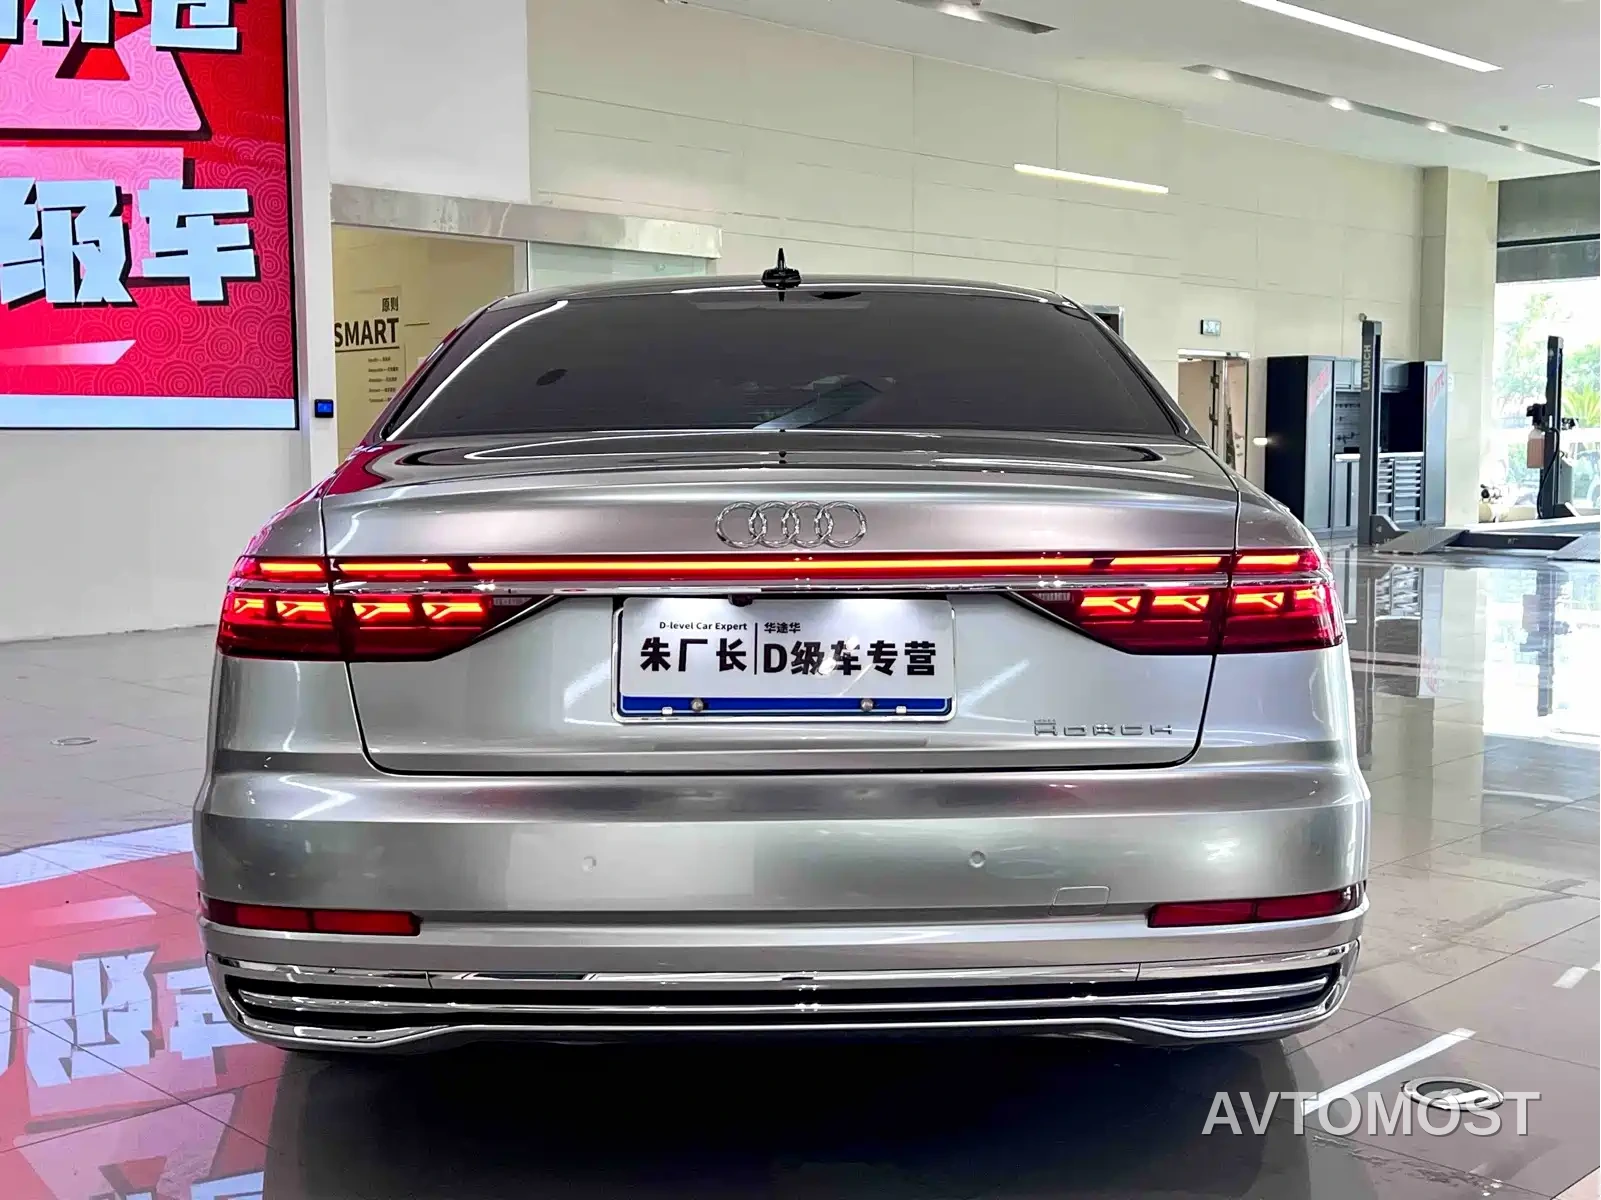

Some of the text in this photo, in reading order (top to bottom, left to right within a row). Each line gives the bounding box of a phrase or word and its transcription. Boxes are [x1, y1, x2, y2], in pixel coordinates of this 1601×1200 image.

[0, 177, 257, 304] 级车
[381, 296, 399, 312] 原则
[334, 317, 400, 348] SMART
[1361, 344, 1372, 391] LAUNCH
[659, 621, 748, 632] D-level Car Expert
[763, 622, 801, 634] 华途华
[639, 637, 748, 672] 朱厂长
[763, 640, 937, 676] D级车专营
